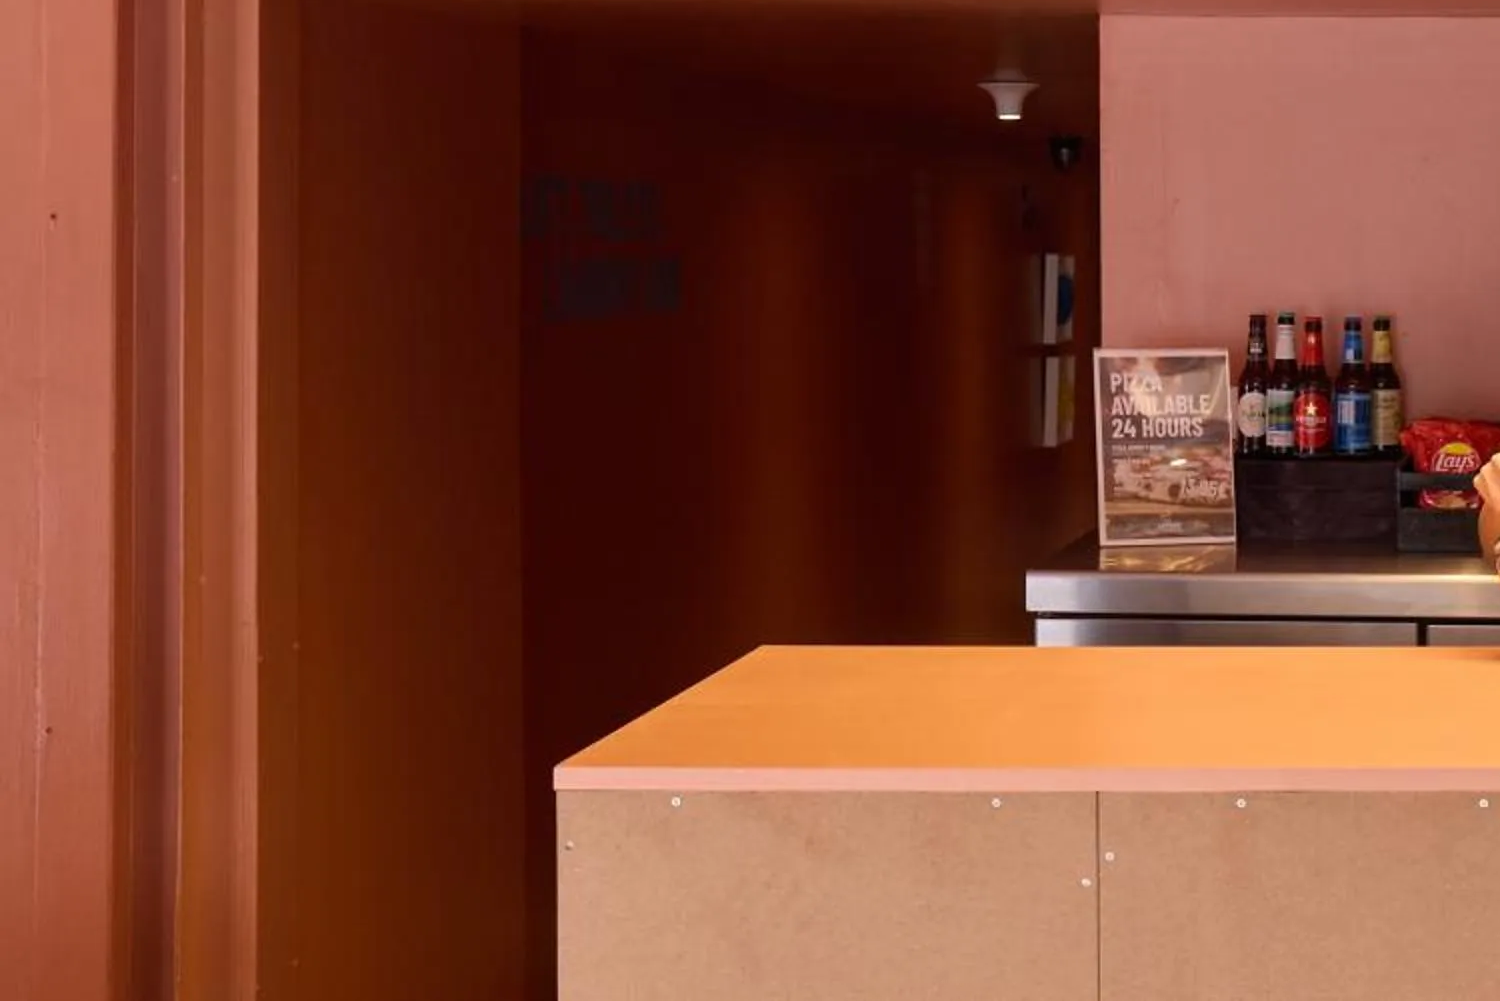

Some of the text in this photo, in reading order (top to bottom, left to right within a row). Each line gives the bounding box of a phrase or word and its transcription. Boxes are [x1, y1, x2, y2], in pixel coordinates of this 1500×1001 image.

[1111, 394, 1211, 416] AVAILABLE
[1111, 416, 1204, 439] 24 HOURS
